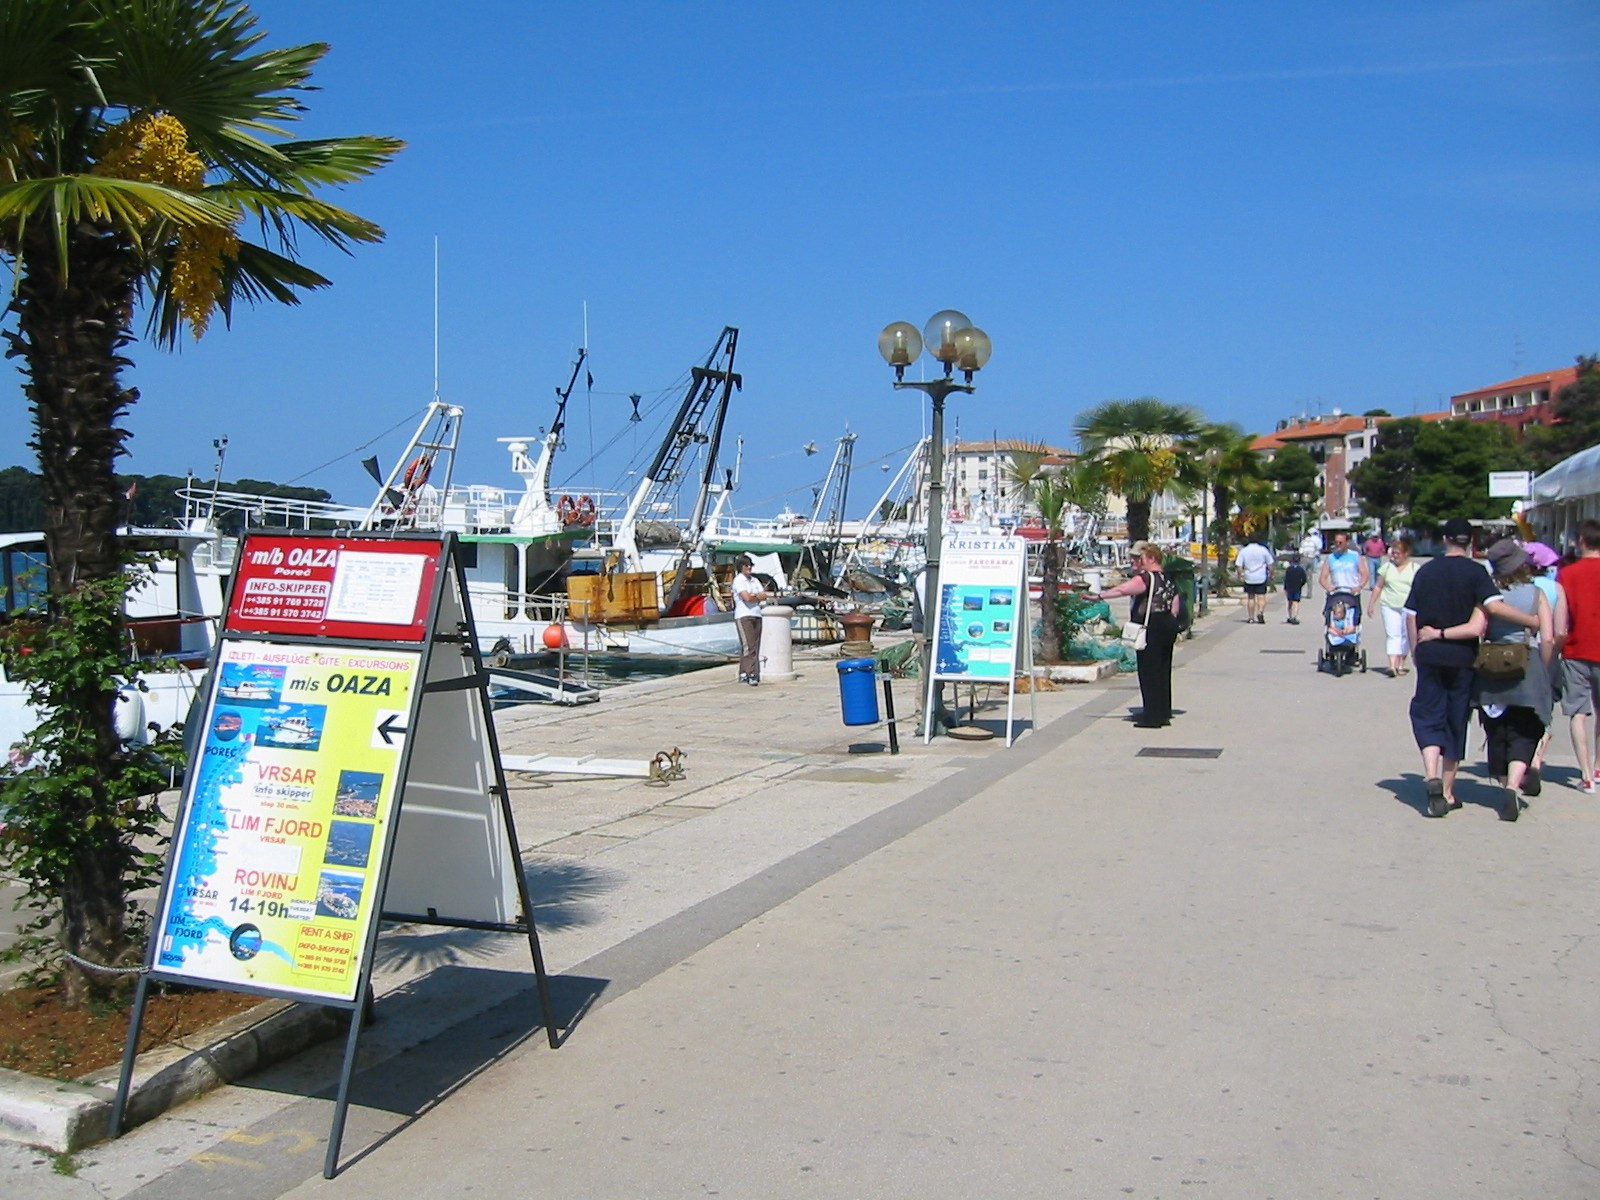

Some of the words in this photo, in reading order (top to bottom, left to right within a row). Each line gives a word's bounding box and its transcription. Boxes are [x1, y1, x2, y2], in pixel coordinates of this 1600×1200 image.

[948, 540, 1016, 550] KRISTIAN
[251, 547, 284, 566] m/b
[288, 547, 337, 568] OAZA
[249, 582, 327, 594] INFO-SKIPPER
[318, 656, 341, 667] GITE
[348, 658, 410, 671] EXCURSIONS
[326, 673, 392, 696] OAZA
[259, 765, 317, 785] VRSAR
[254, 785, 274, 795] info
[276, 787, 311, 799] skipper
[231, 814, 261, 831] LIM
[264, 817, 323, 838] FJORD
[260, 836, 286, 845] VRSAR
[234, 868, 299, 892] ROVINJ
[187, 887, 219, 899] VRSAR
[229, 896, 289, 919] 14-19h
[174, 927, 203, 939] FJORD
[300, 926, 324, 937] RENT
[324, 930, 331, 939] A
[332, 930, 353, 941] SHIP
